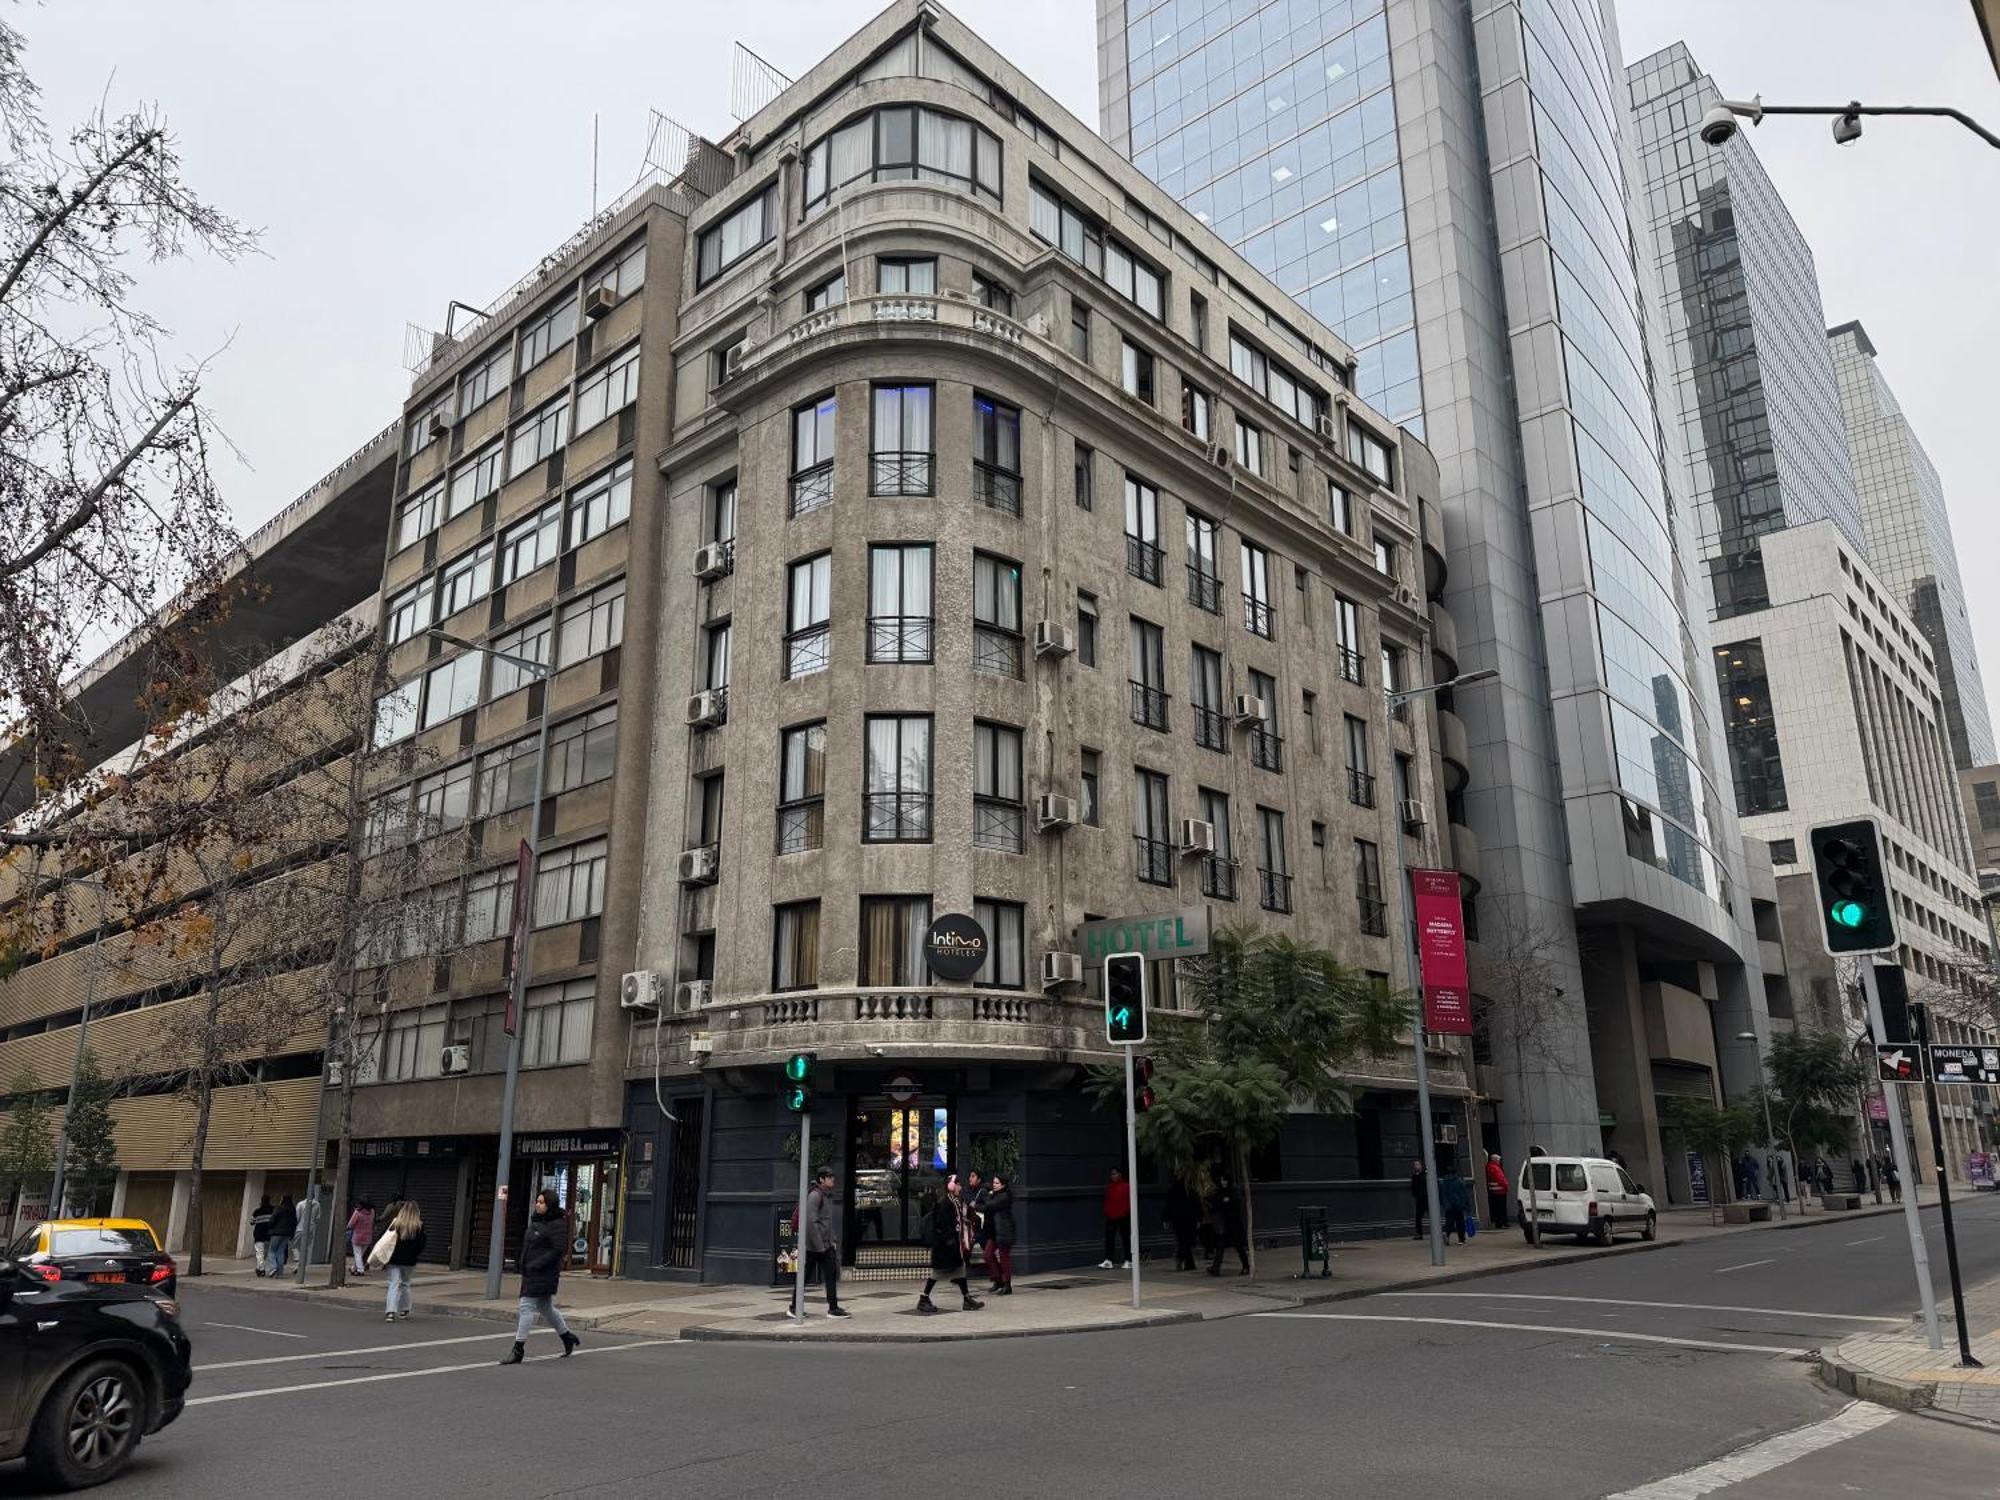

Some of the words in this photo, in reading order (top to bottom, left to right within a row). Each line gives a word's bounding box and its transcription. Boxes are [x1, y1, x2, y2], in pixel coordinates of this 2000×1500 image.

[1087, 917, 1194, 960] HOTEL
[936, 948, 976, 957] HOTELES
[1934, 1049, 1975, 1058] MONEDA
